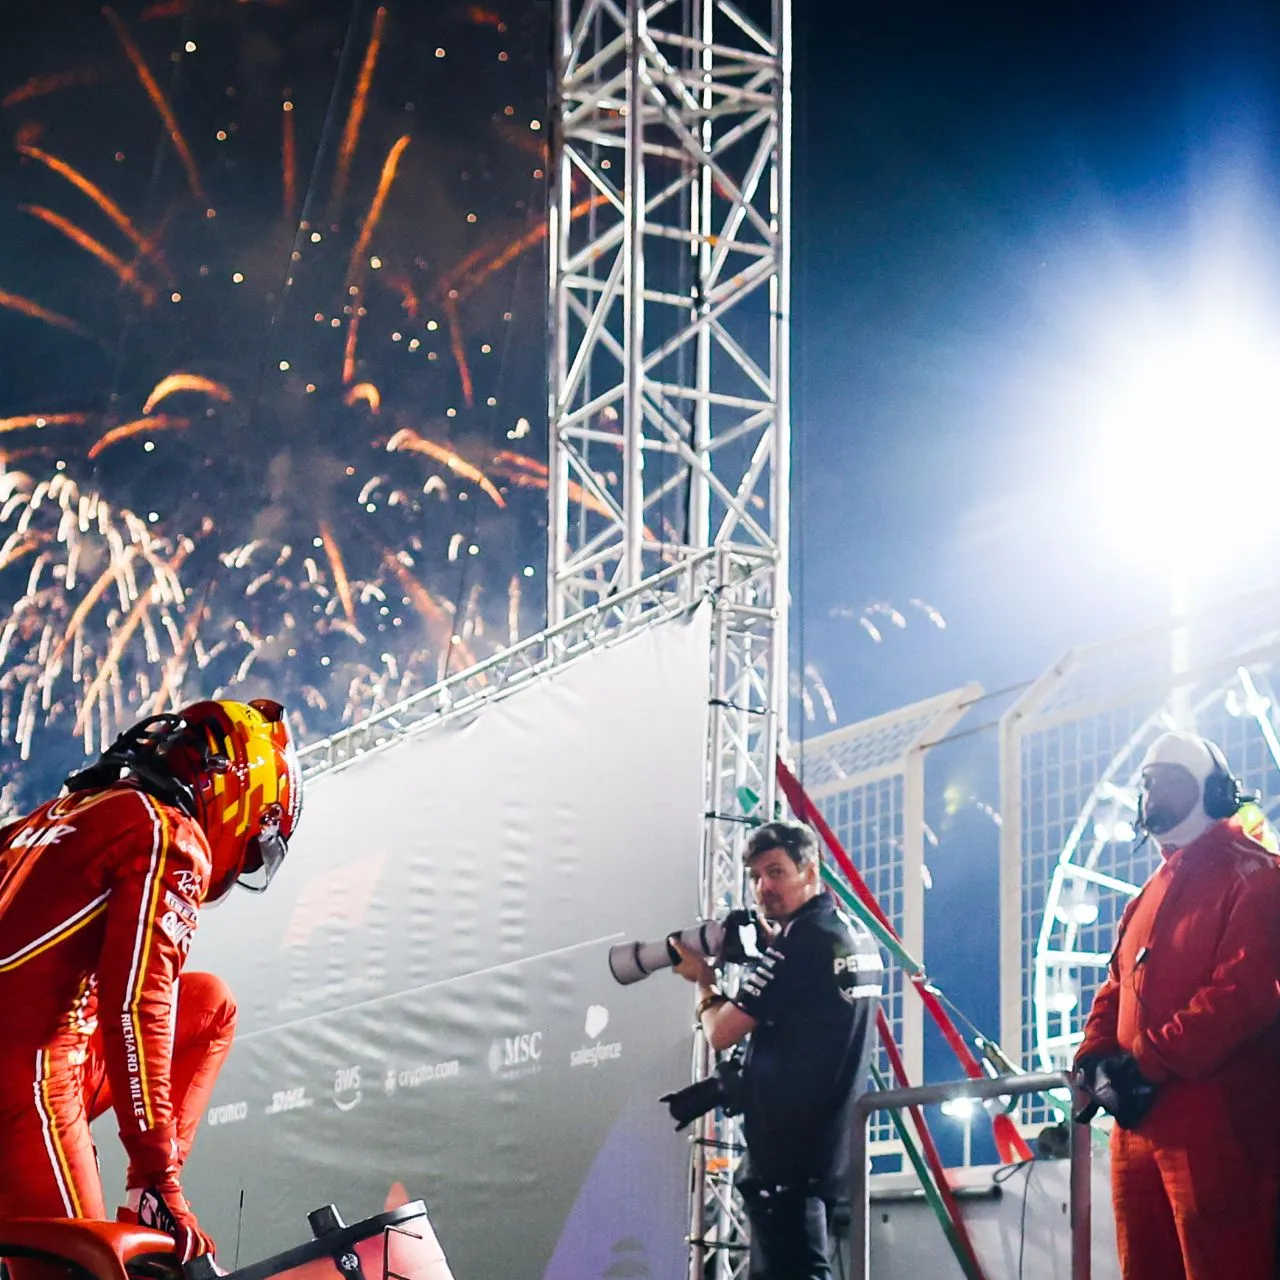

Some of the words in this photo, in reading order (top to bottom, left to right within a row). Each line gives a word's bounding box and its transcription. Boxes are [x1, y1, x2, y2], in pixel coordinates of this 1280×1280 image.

[504, 1031, 543, 1066] MSC
[570, 1041, 622, 1068] salesforce
[120, 1012, 138, 1072] RICHARD
[129, 1076, 145, 1117] MILLE
[334, 1066, 361, 1093] aws
[208, 1101, 247, 1125] aramco
